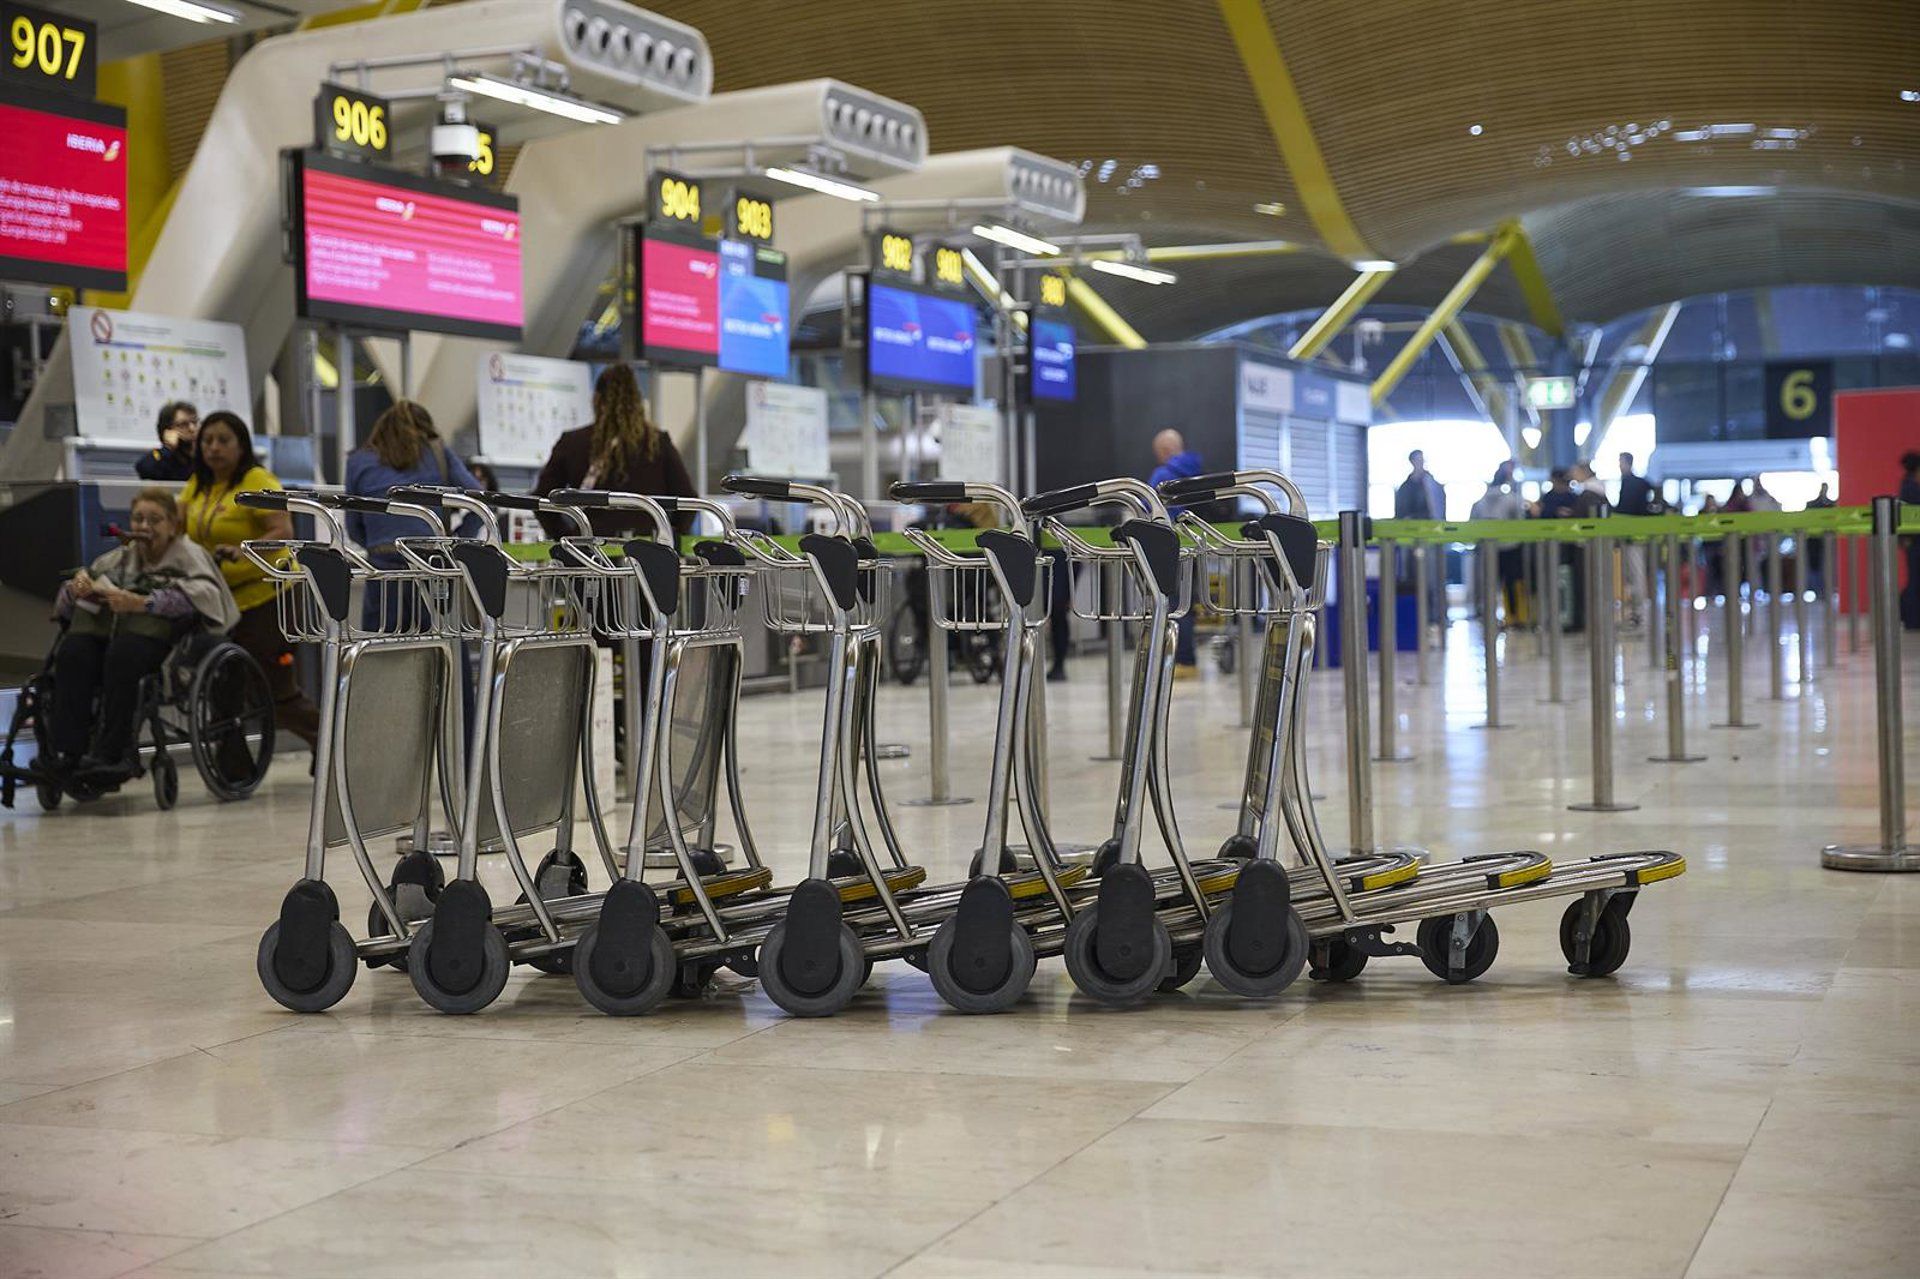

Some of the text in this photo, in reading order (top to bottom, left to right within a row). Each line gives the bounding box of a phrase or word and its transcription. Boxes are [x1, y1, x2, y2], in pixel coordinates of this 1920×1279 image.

[11, 16, 86, 80] 907
[66, 132, 107, 155] IBERIA
[333, 96, 387, 150] 906
[661, 178, 700, 223] 904
[1781, 369, 1817, 420] 6
